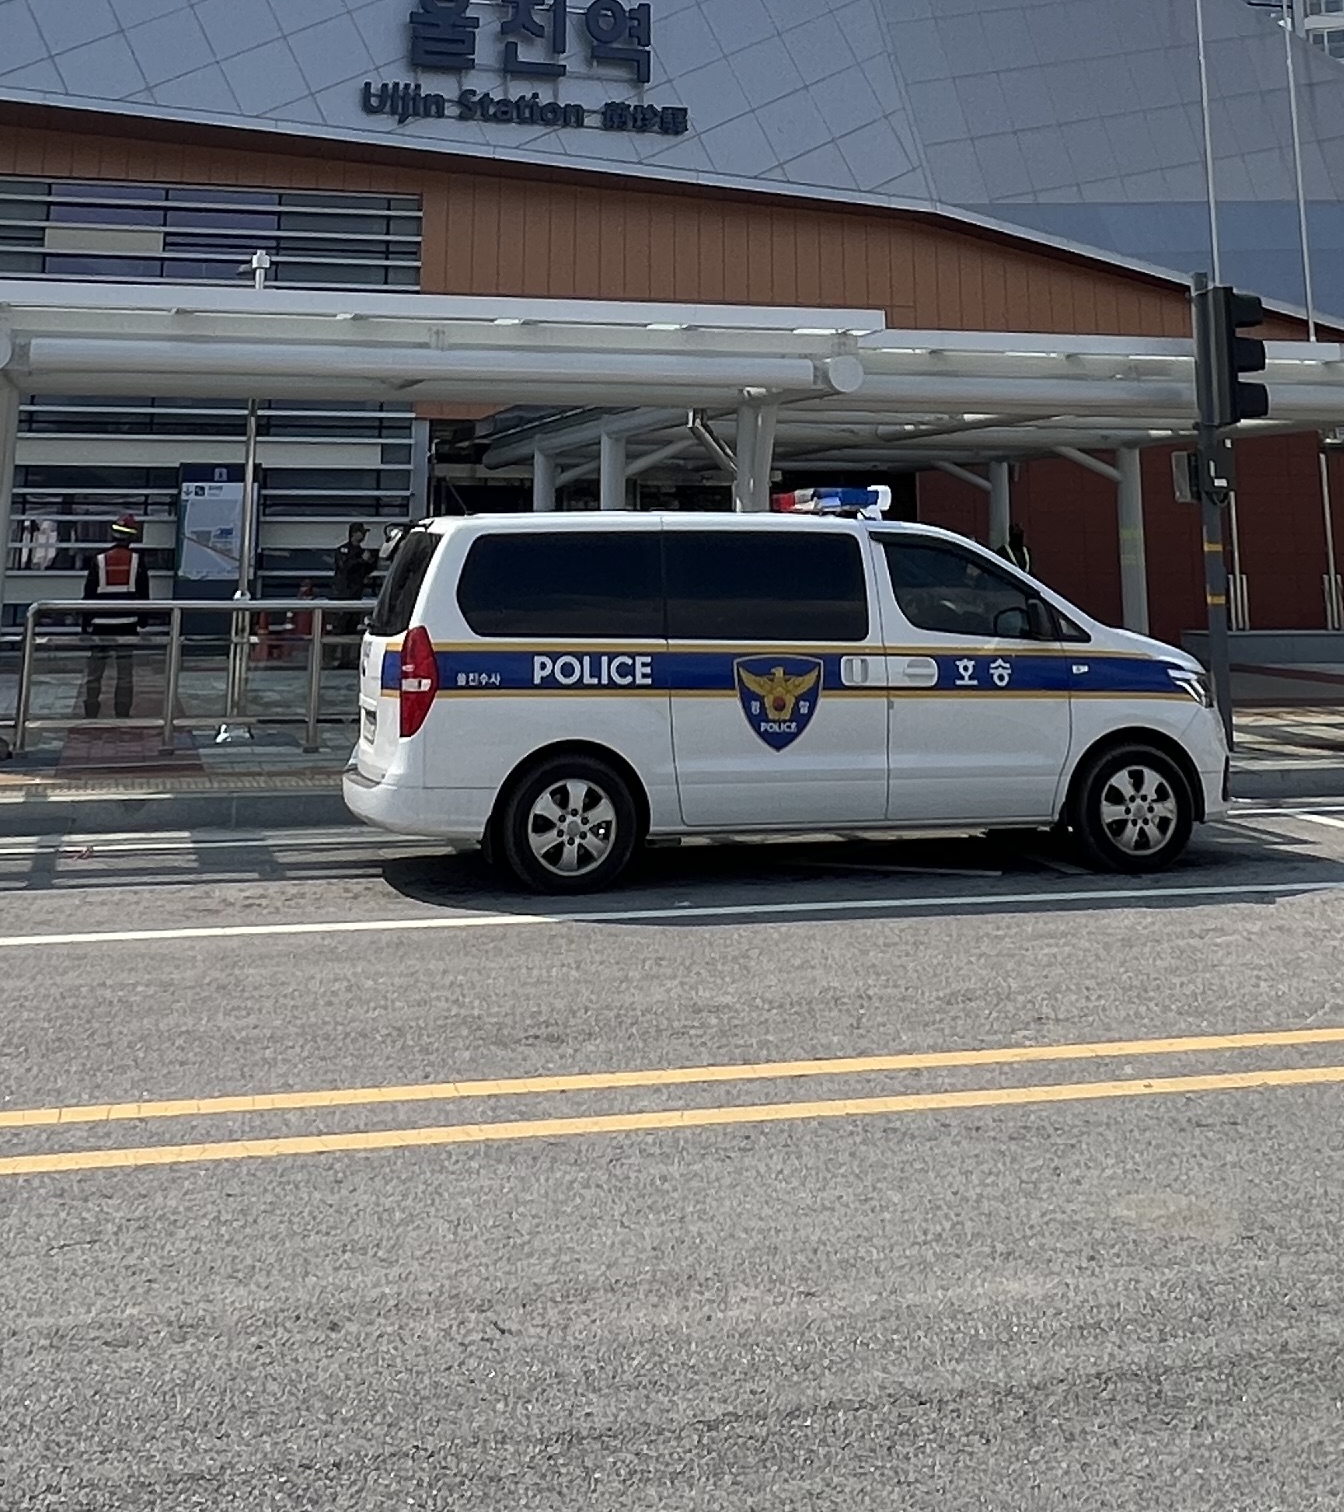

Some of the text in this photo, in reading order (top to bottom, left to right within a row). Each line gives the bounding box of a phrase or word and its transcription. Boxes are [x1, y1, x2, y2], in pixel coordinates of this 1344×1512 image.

[458, 88, 585, 128] Station
[532, 654, 653, 686] POLICE
[760, 721, 798, 733] POLICE
